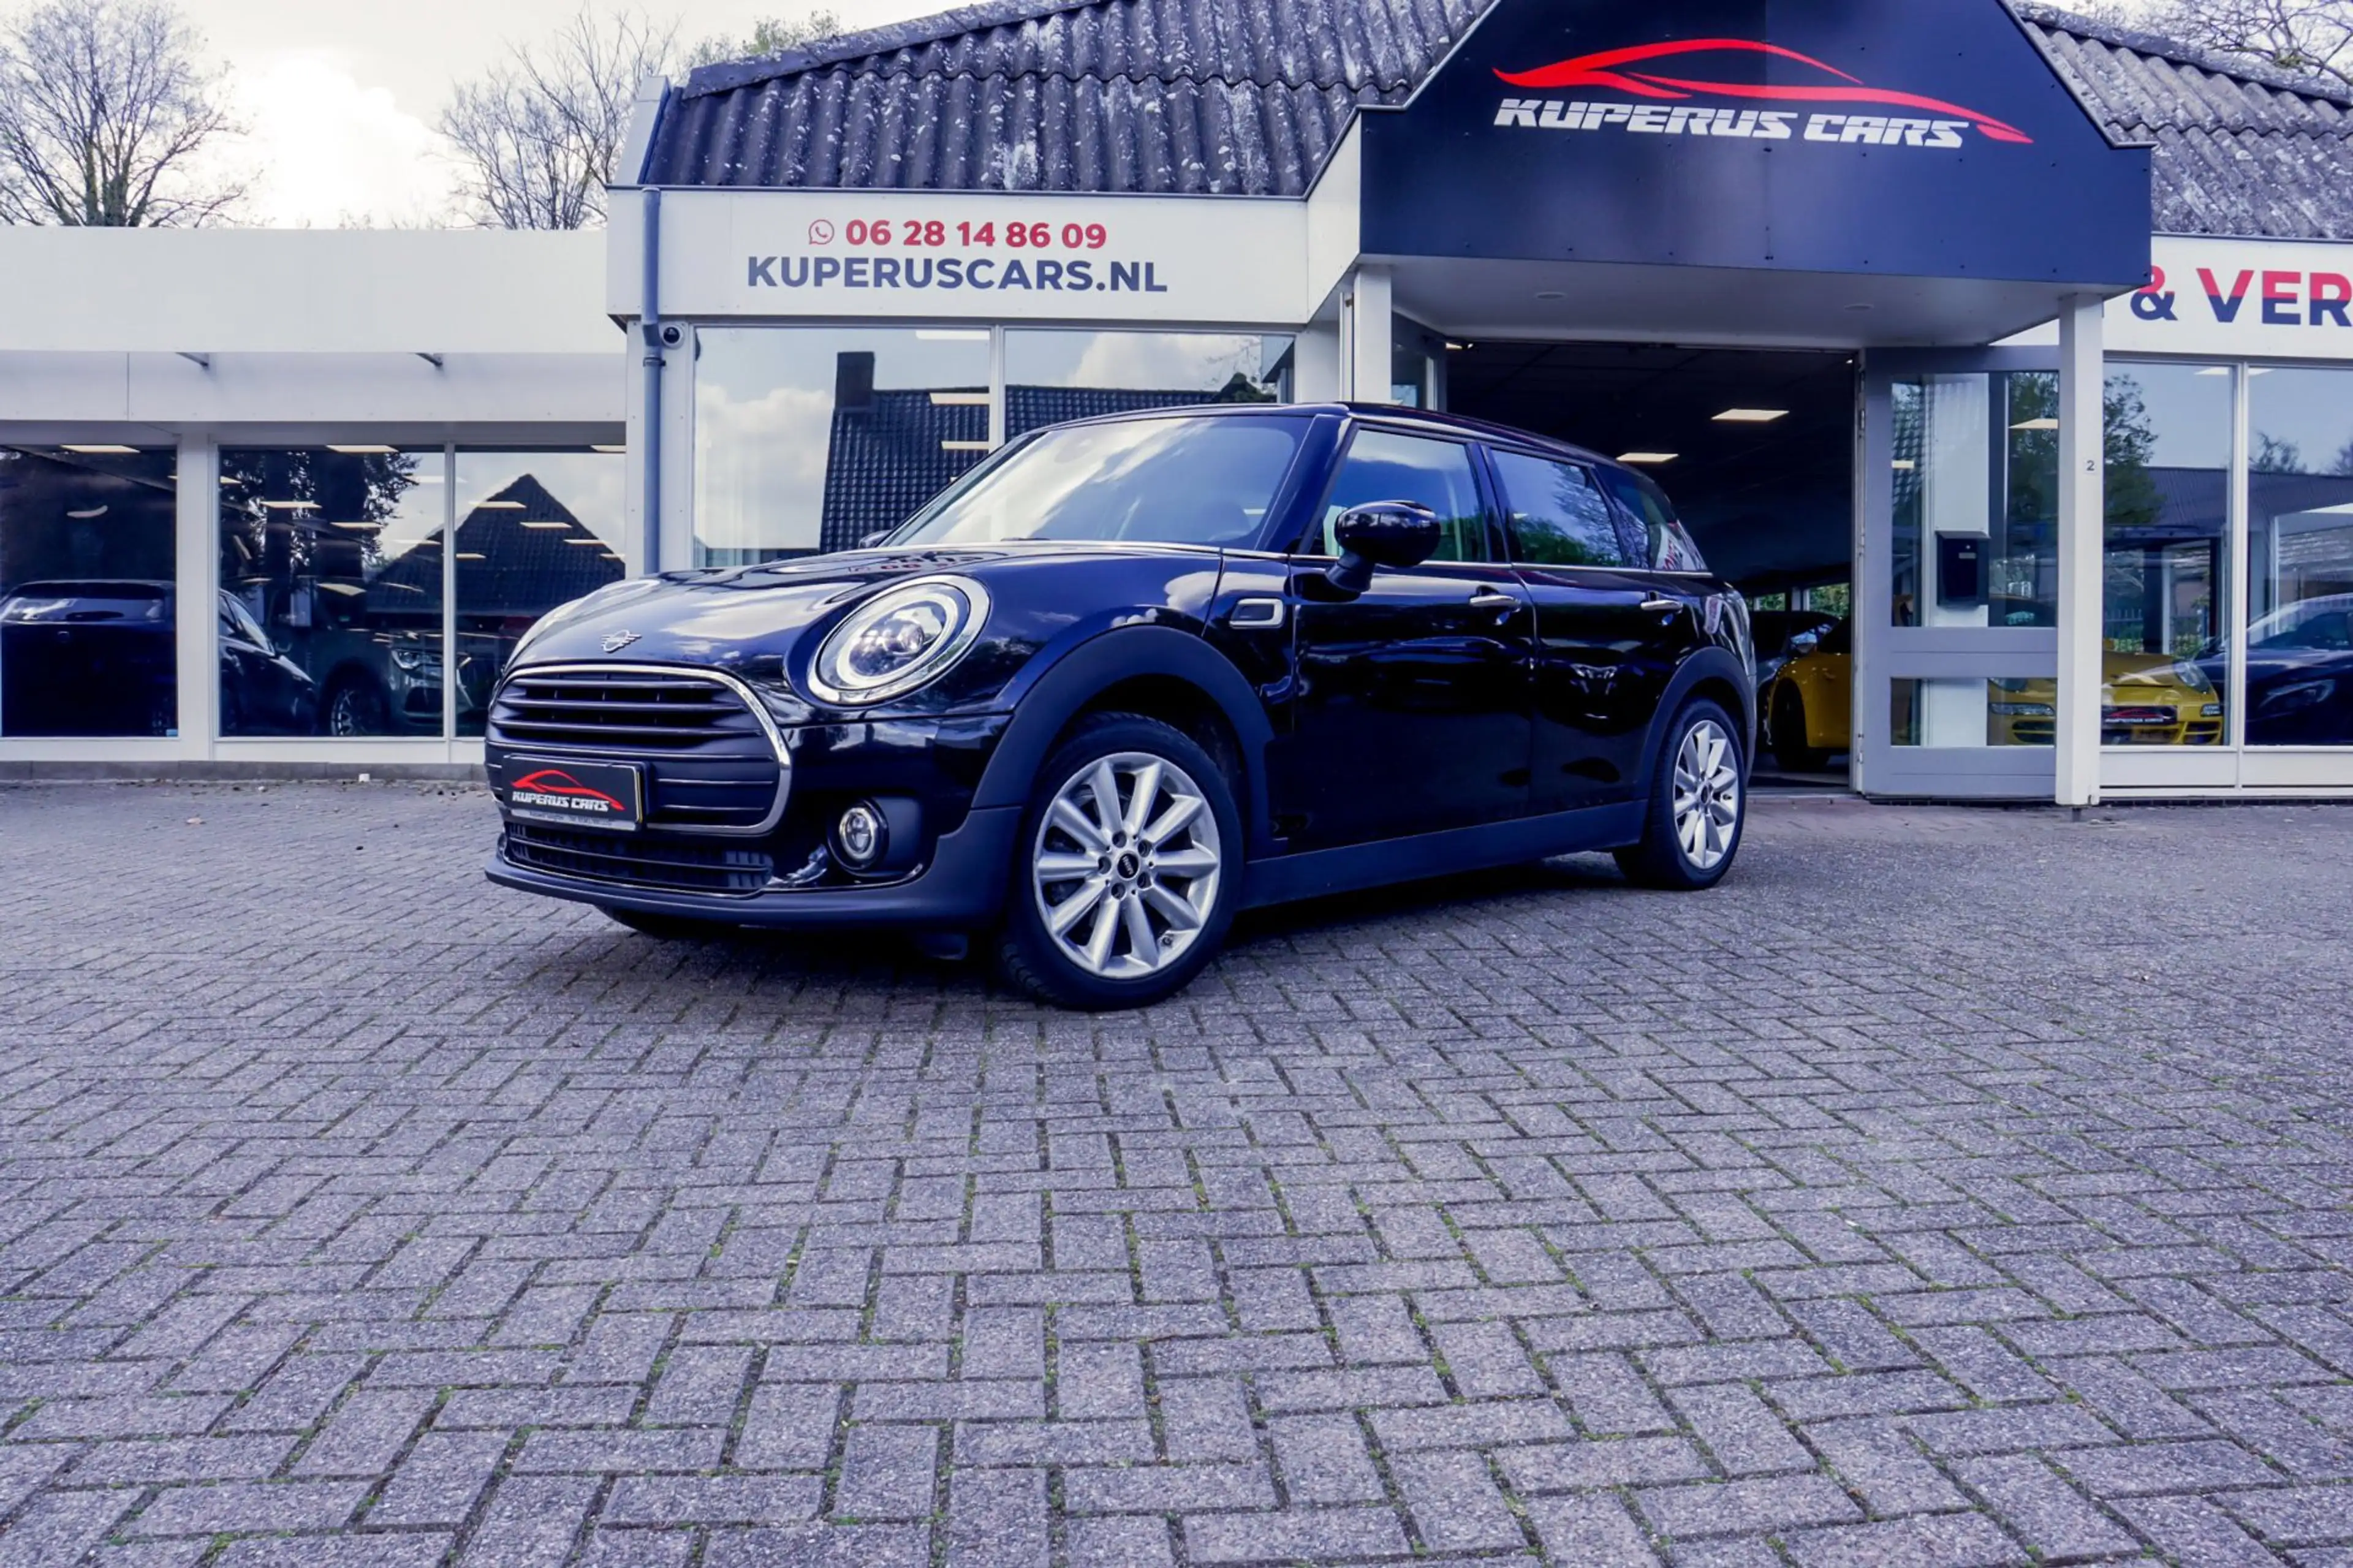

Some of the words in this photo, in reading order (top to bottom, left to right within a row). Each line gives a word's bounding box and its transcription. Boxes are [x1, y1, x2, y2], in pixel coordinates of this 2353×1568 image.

[1494, 99, 1798, 140] KUPERUS
[1803, 113, 1969, 148] CARS
[846, 218, 892, 246] 06
[904, 219, 945, 247] 28
[958, 221, 996, 247] 14
[1005, 221, 1051, 248] 86
[1062, 222, 1107, 249] 09
[748, 256, 1168, 292] KUPERUSCARS.NL
[2086, 460, 2095, 471] 2
[512, 790, 570, 808] KUPERUS
[570, 797, 610, 812] CARS
